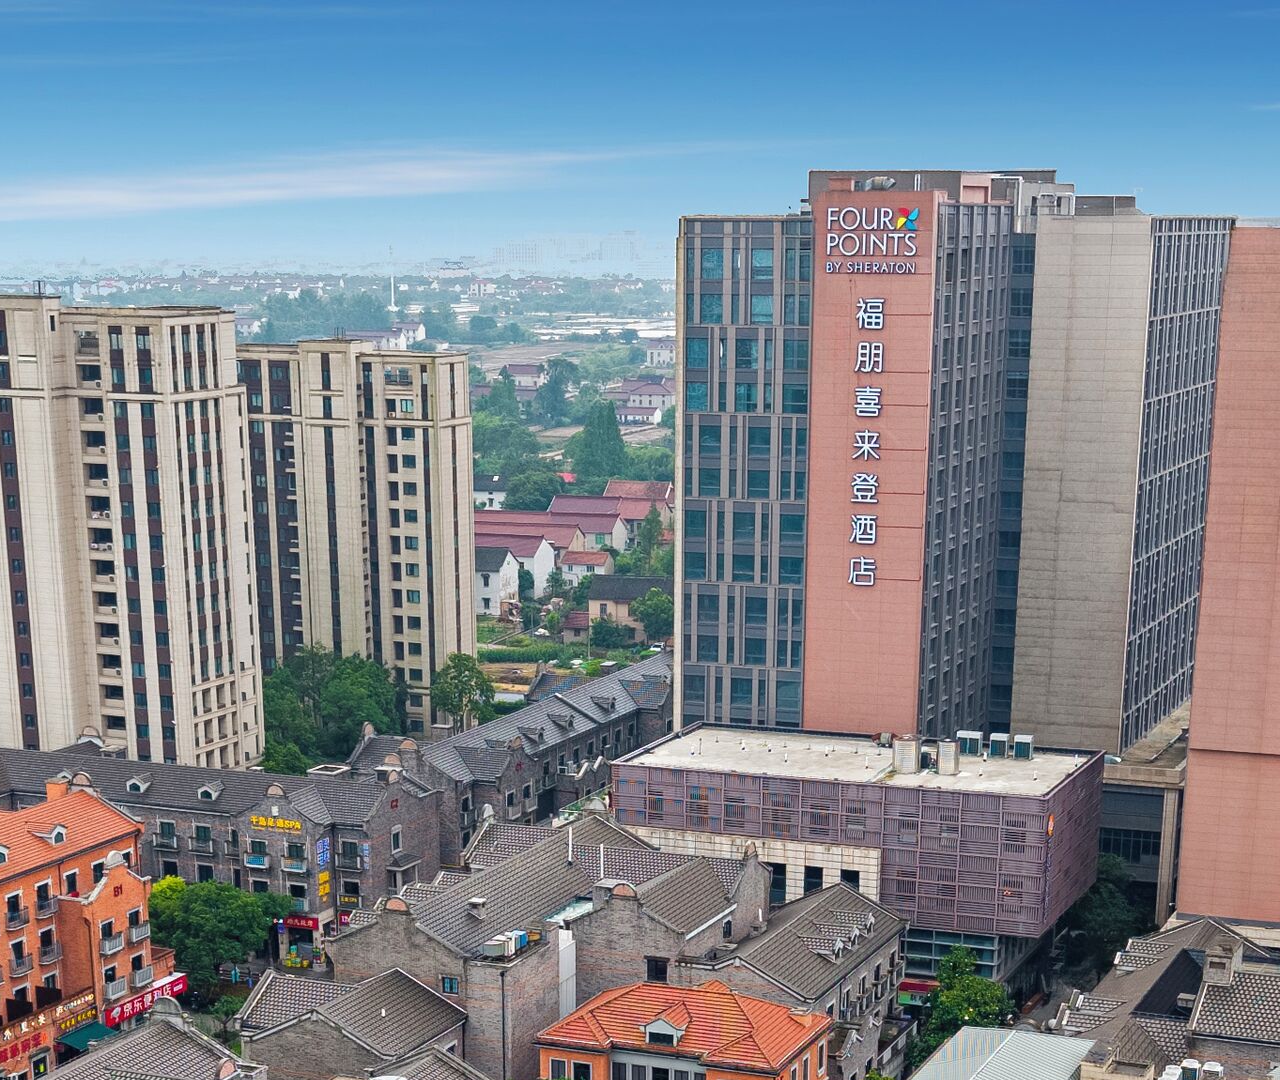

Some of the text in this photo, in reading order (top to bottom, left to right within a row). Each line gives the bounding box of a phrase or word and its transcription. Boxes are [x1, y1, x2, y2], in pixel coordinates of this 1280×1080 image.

[827, 207, 894, 230] FOUR
[826, 232, 917, 256] POINTS
[826, 261, 915, 273] BY SHERATON
[847, 297, 885, 586] 福朋喜来登酒店
[113, 884, 123, 897] B1
